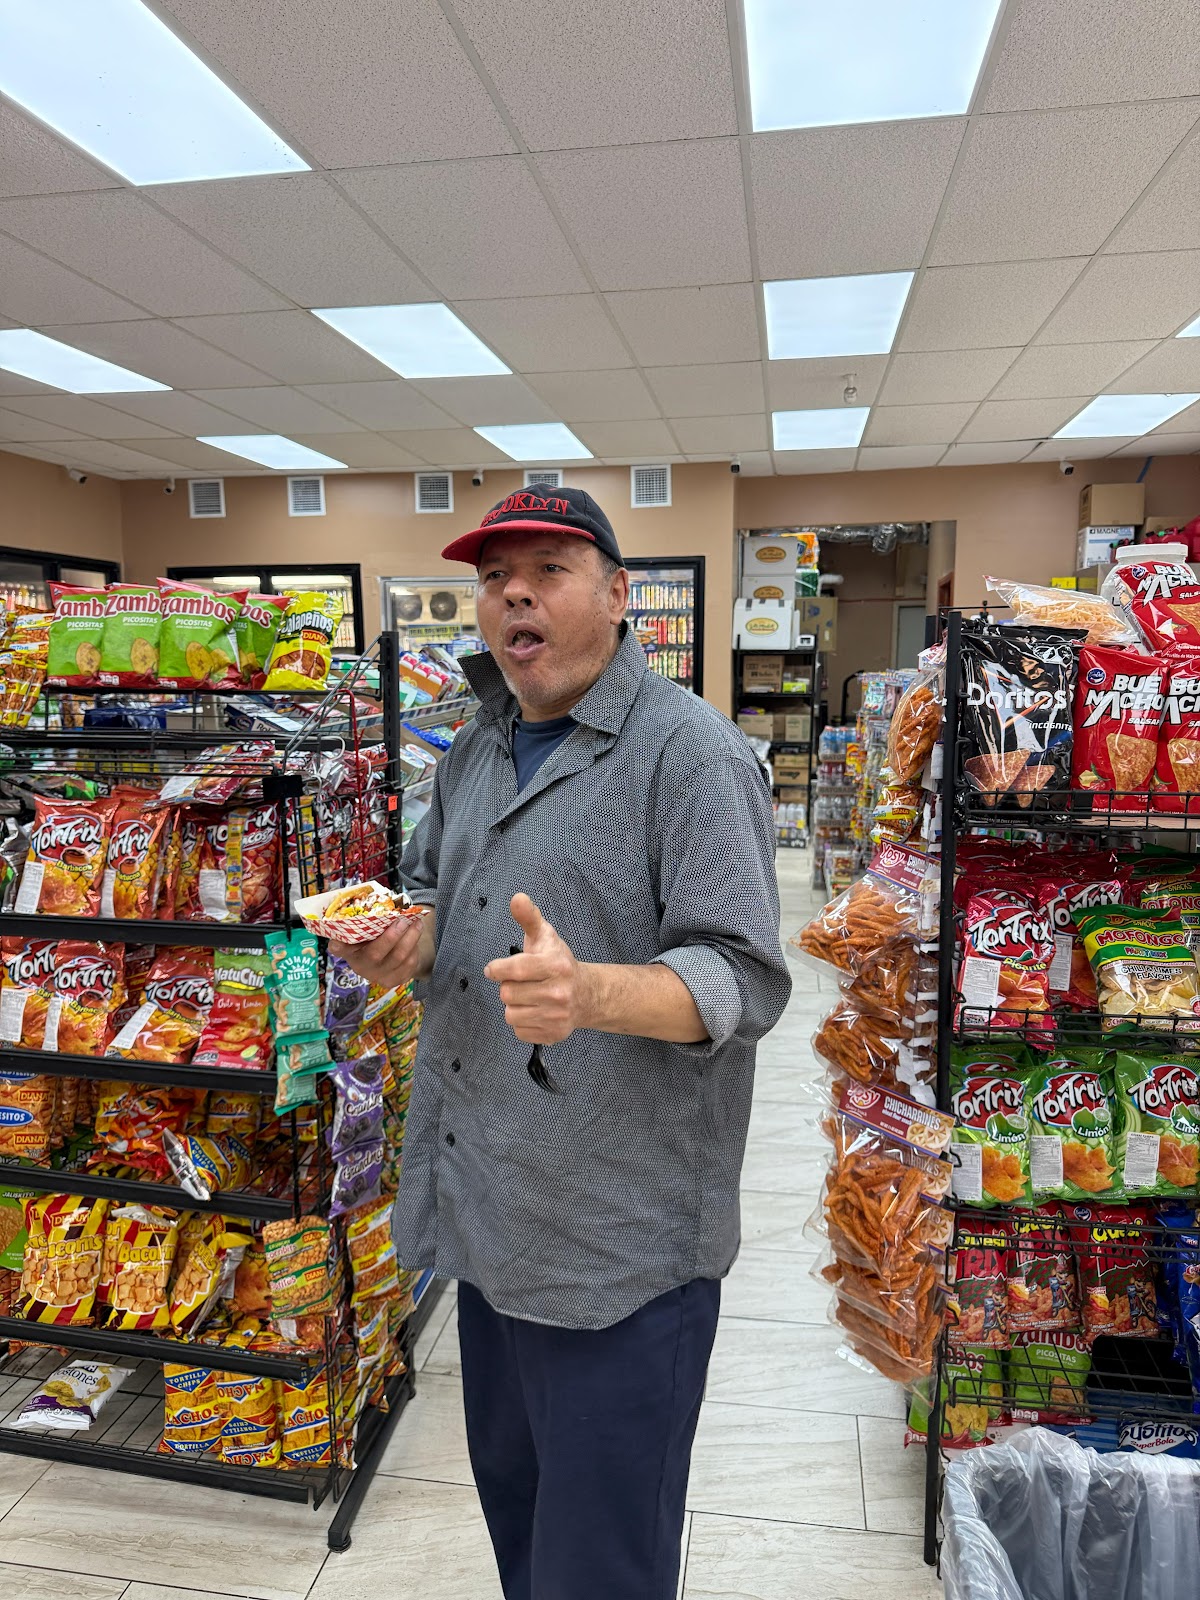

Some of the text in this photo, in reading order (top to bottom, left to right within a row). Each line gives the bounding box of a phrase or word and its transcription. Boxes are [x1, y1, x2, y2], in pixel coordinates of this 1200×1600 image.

[480, 493, 569, 527] BROOKLYN
[1137, 572, 1200, 606] NACH
[53, 598, 104, 621] Zamb
[104, 594, 160, 616] Zamb
[67, 621, 104, 630] PICOSITAS
[123, 616, 158, 625] PICOSITAS
[175, 618, 213, 628] PICOSITAS
[281, 611, 334, 634] Jalapeños
[966, 682, 1069, 710] Doritos
[1082, 689, 1164, 728] NACHO
[32, 817, 101, 853] TorTrix
[968, 911, 1054, 952] TorTrix
[1096, 929, 1186, 946] MOFONGO
[279, 956, 315, 970] YUMMI
[1003, 957, 1047, 973] Picante
[215, 967, 265, 987] NatuChi
[287, 969, 313, 981] NUTS
[1137, 972, 1172, 981] FLAVOR
[20, 1090, 49, 1102] DIANA
[952, 1079, 1024, 1119] TorTrix
[1033, 1074, 1105, 1125] TorTrix
[0, 1112, 26, 1123] ESITOS
[884, 1095, 941, 1131] CHICHARRINES
[1076, 1125, 1109, 1138] Limón
[1175, 1121, 1200, 1135] Limó
[16, 1134, 45, 1145] DIANA
[992, 1132, 1027, 1144] Limón
[119, 1242, 175, 1263] Bacorn
[957, 1249, 1009, 1280] TRIX
[1036, 1348, 1076, 1364] PICOSITAS
[169, 1371, 207, 1385] TORTILLA
[177, 1379, 201, 1389] CHIPS
[217, 1383, 265, 1398] NACHO
[224, 1425, 257, 1434] TORTILLA
[222, 1451, 275, 1466] NACHO
